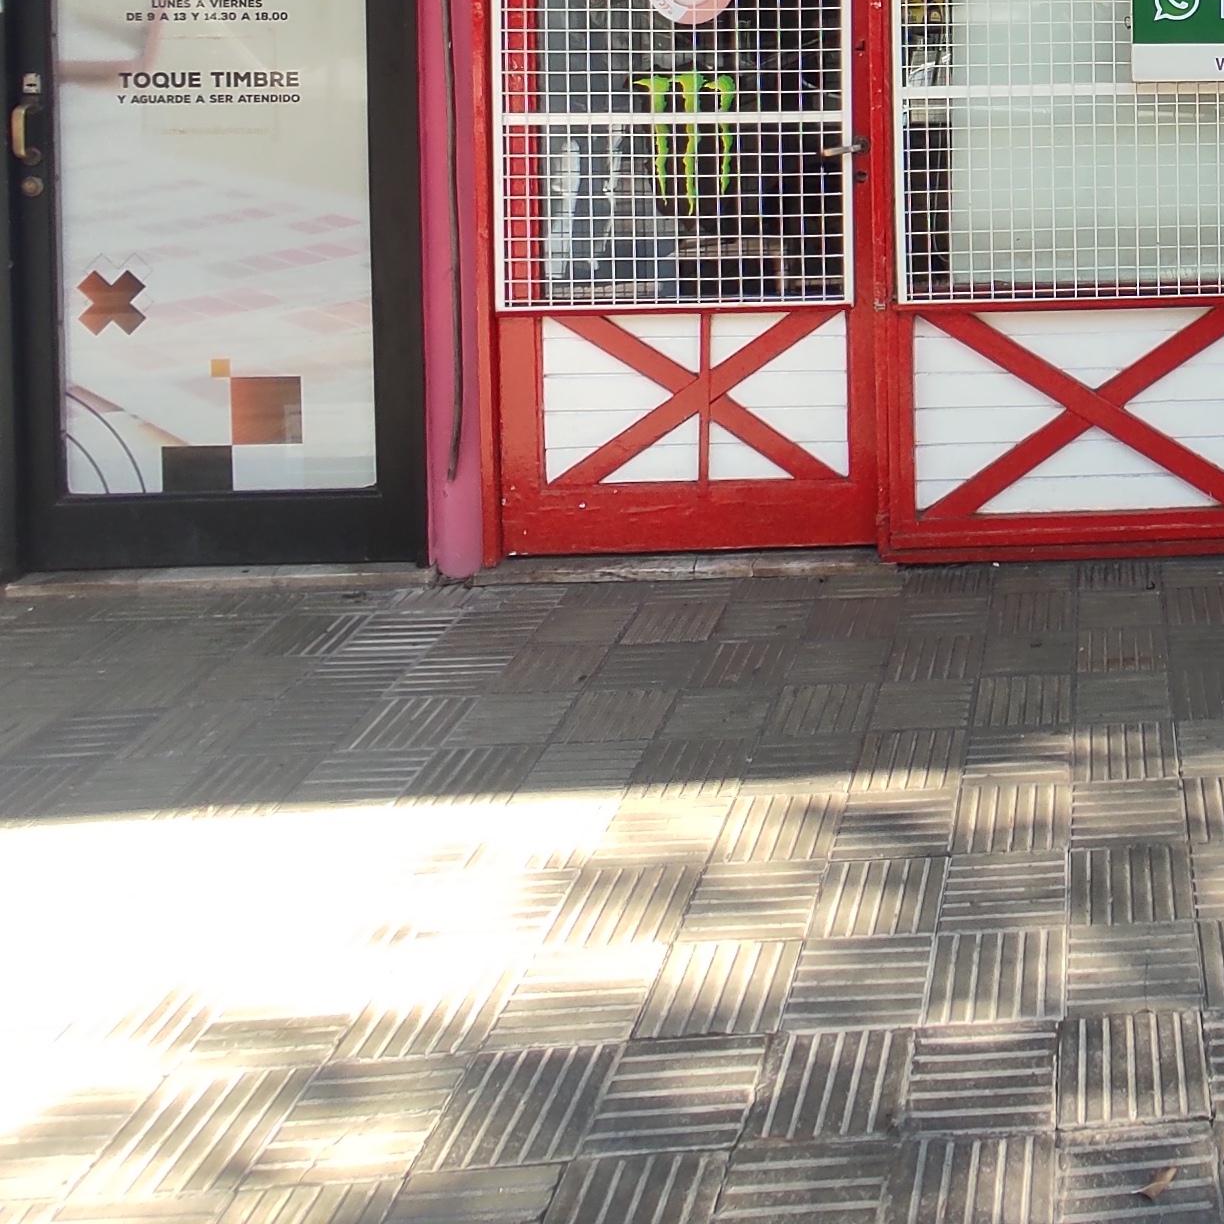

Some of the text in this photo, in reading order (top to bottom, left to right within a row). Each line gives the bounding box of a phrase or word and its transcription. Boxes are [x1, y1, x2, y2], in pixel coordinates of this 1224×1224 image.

[151, 0, 263, 8] LUNES A VIERNES
[126, 12, 288, 21] DE 9 A 13 Y 14.30 A 18.00
[118, 71, 300, 89] TOQUE TIMBRE
[117, 94, 301, 104] Y AGUARDE A SER ATENDIDO
